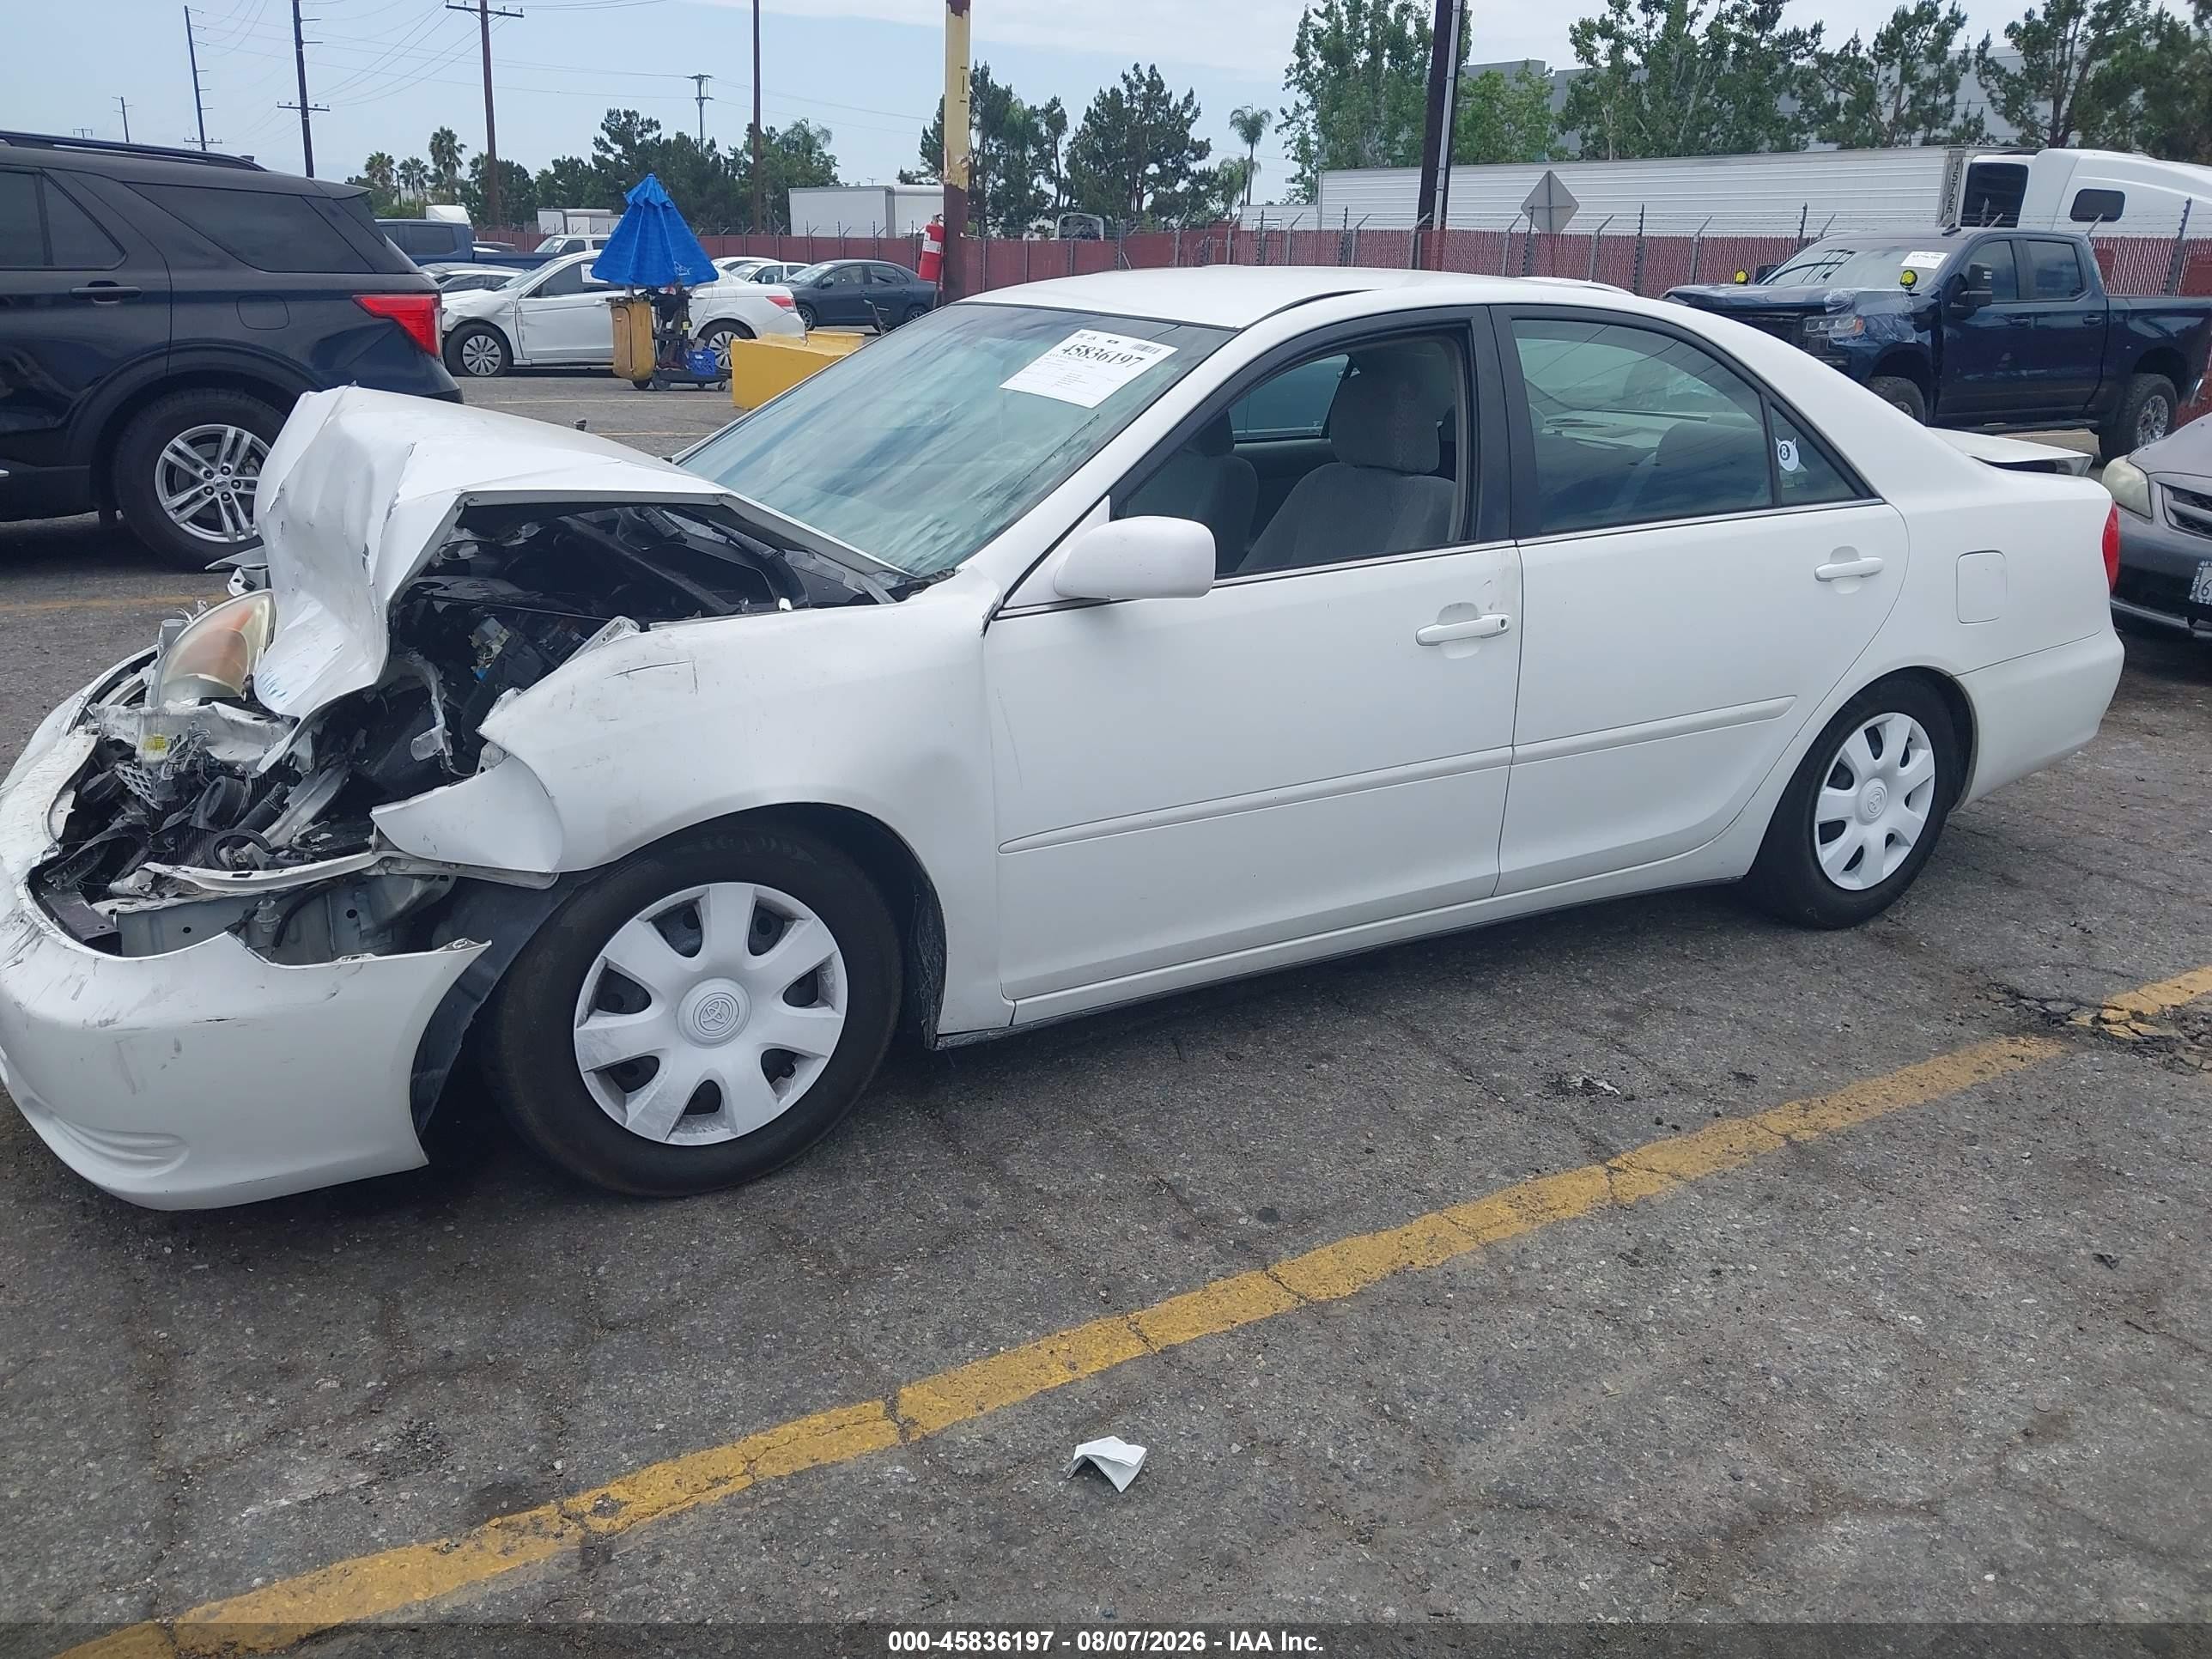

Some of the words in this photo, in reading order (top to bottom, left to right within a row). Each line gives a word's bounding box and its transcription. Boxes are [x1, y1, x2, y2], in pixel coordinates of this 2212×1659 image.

[1946, 161, 1959, 214] 15725
[1061, 343, 1146, 368] 45836197
[1781, 445, 1788, 459] 8
